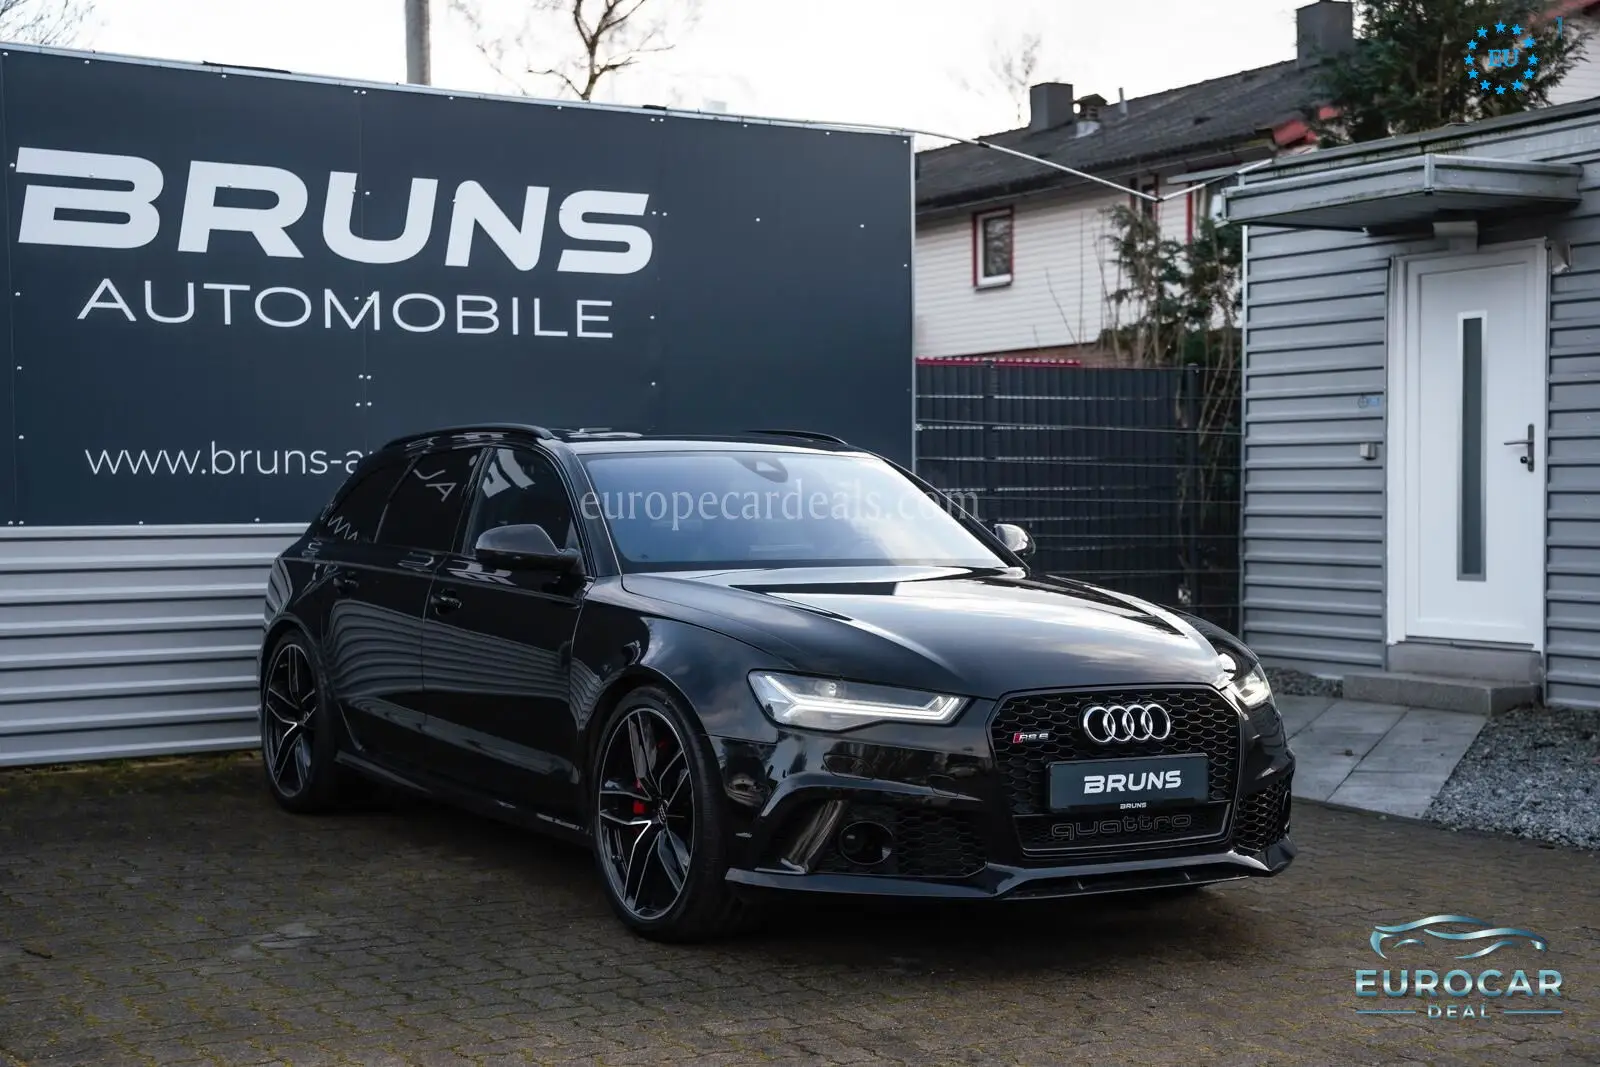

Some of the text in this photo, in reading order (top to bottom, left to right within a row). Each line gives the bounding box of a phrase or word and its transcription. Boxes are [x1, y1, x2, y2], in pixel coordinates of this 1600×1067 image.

[15, 146, 653, 275] BRUNS
[77, 278, 613, 339] AUTOMOBILE
[85, 440, 372, 475] www.bruns-a
[1083, 770, 1182, 794] BRUNS
[1119, 802, 1147, 810] BRUNS
[1051, 814, 1192, 840] quattro
